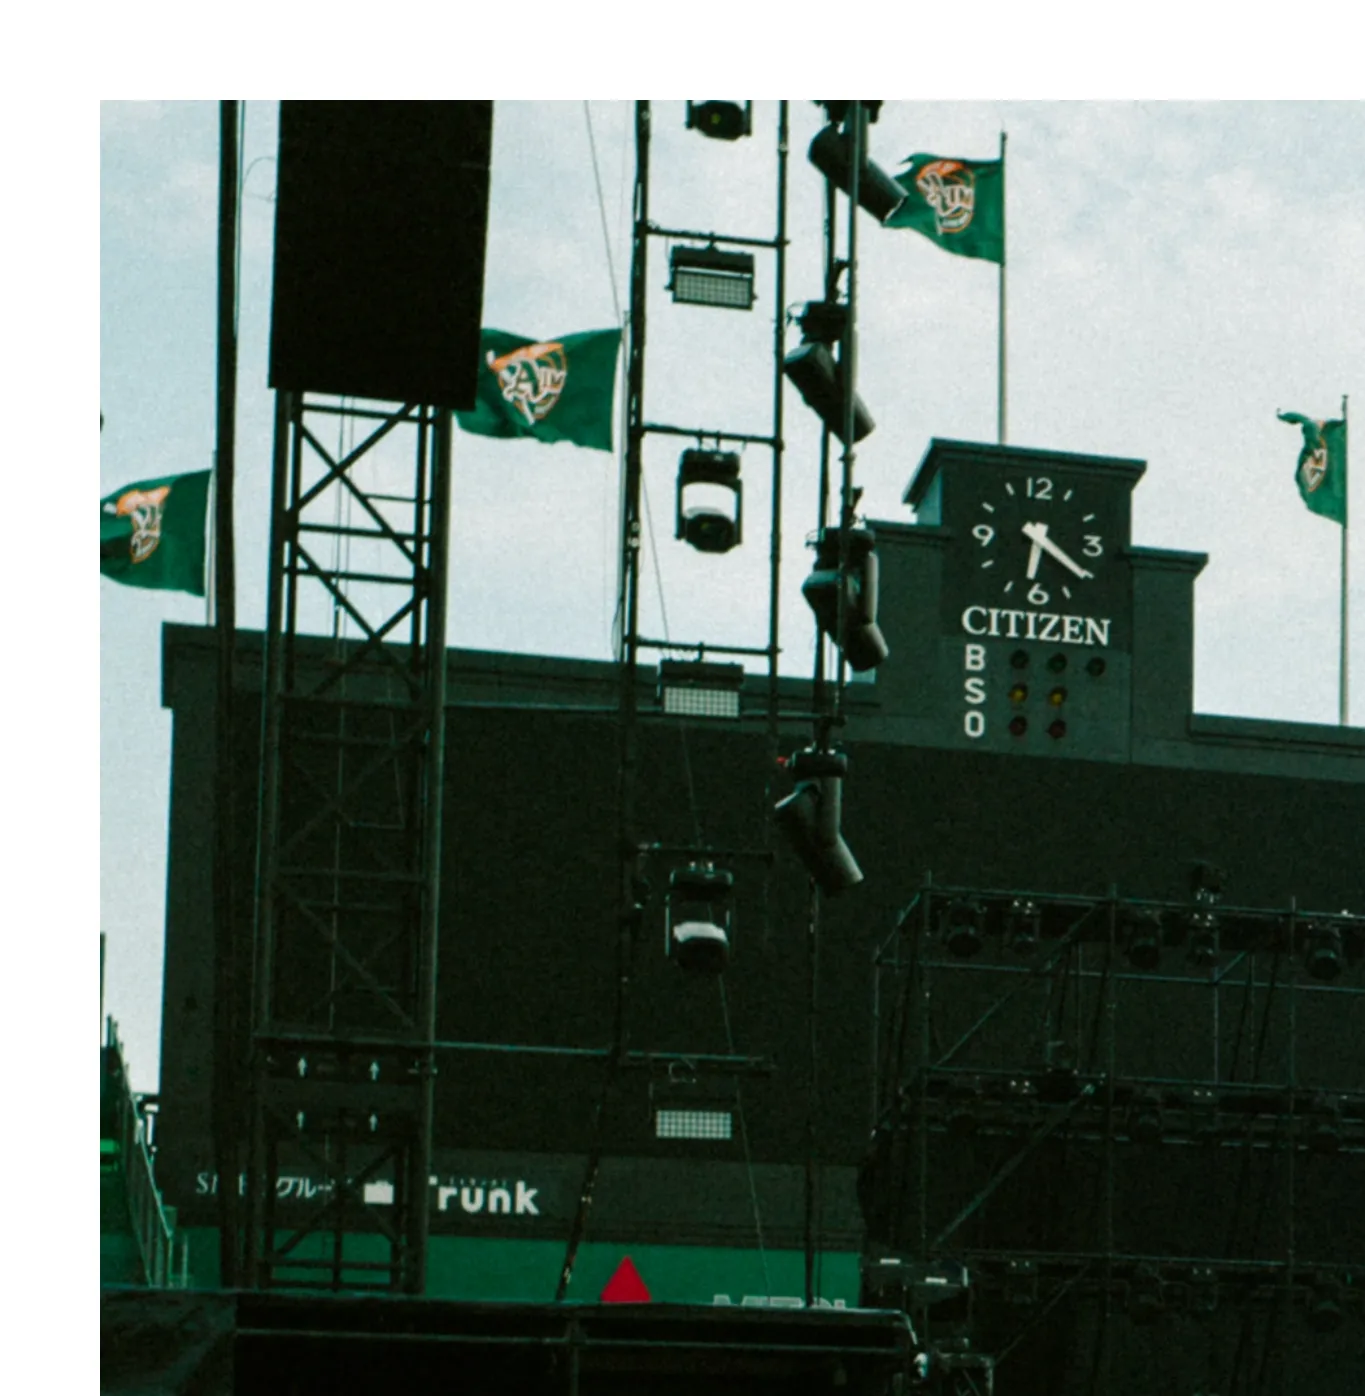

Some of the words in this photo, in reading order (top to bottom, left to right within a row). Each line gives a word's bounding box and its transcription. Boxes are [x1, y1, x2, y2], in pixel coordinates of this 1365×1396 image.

[1026, 477, 1053, 500] 12
[972, 524, 994, 547] 9
[1082, 535, 1103, 557] 3
[1027, 583, 1050, 605] 6
[961, 605, 1112, 647] CITIZEN
[964, 643, 987, 672] B
[964, 677, 987, 705] S
[428, 1174, 540, 1216] runk
